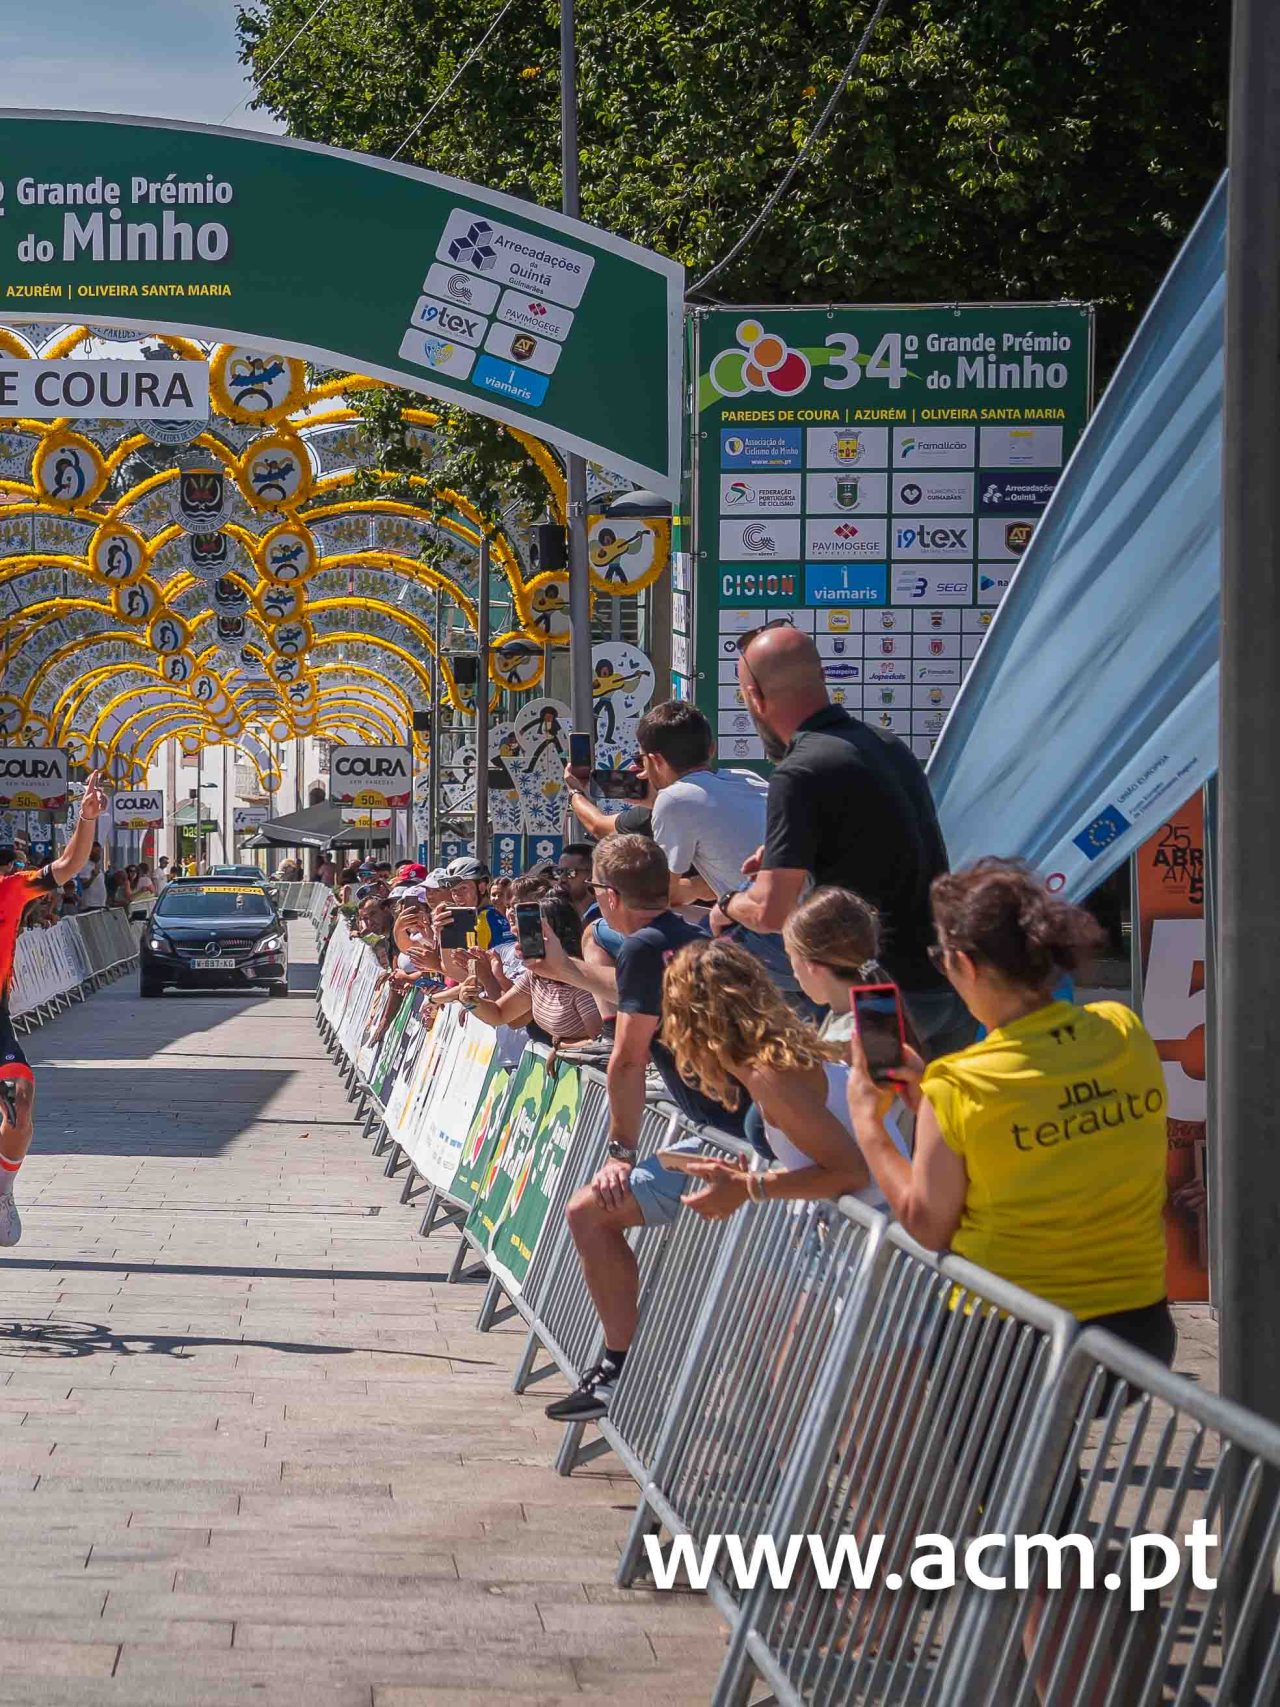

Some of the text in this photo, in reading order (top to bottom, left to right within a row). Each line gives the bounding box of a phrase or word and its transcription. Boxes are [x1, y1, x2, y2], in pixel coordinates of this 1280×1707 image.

[17, 172, 233, 205] Grande Prémio
[18, 210, 229, 263] do Minho
[494, 234, 581, 274] Arrecadações
[509, 262, 552, 287] Quintã
[6, 283, 63, 298] AZURÉM
[77, 285, 139, 297] OLIVEIRA
[141, 284, 182, 297] SANTA
[185, 284, 232, 296] MARIA
[505, 308, 561, 334] PAVIMOGEGE
[926, 331, 1071, 353] Grande Prémio
[823, 332, 919, 390] 34º
[926, 352, 1068, 390] do Minho
[33, 370, 195, 410] COURA
[484, 376, 532, 400] viamaris
[721, 406, 1065, 421] PAREDES DE COURA AZURÉM OLIVEIRA SANTA MARIA
[812, 542, 880, 551] PAVIMOGEGE
[722, 574, 794, 596] CISION
[814, 586, 878, 600] viamaris
[334, 757, 407, 777] COURA
[115, 797, 159, 811] COURA
[1153, 848, 1203, 867] ABR
[1058, 1078, 1117, 1111] JDL
[1011, 1087, 1163, 1152] terauto
